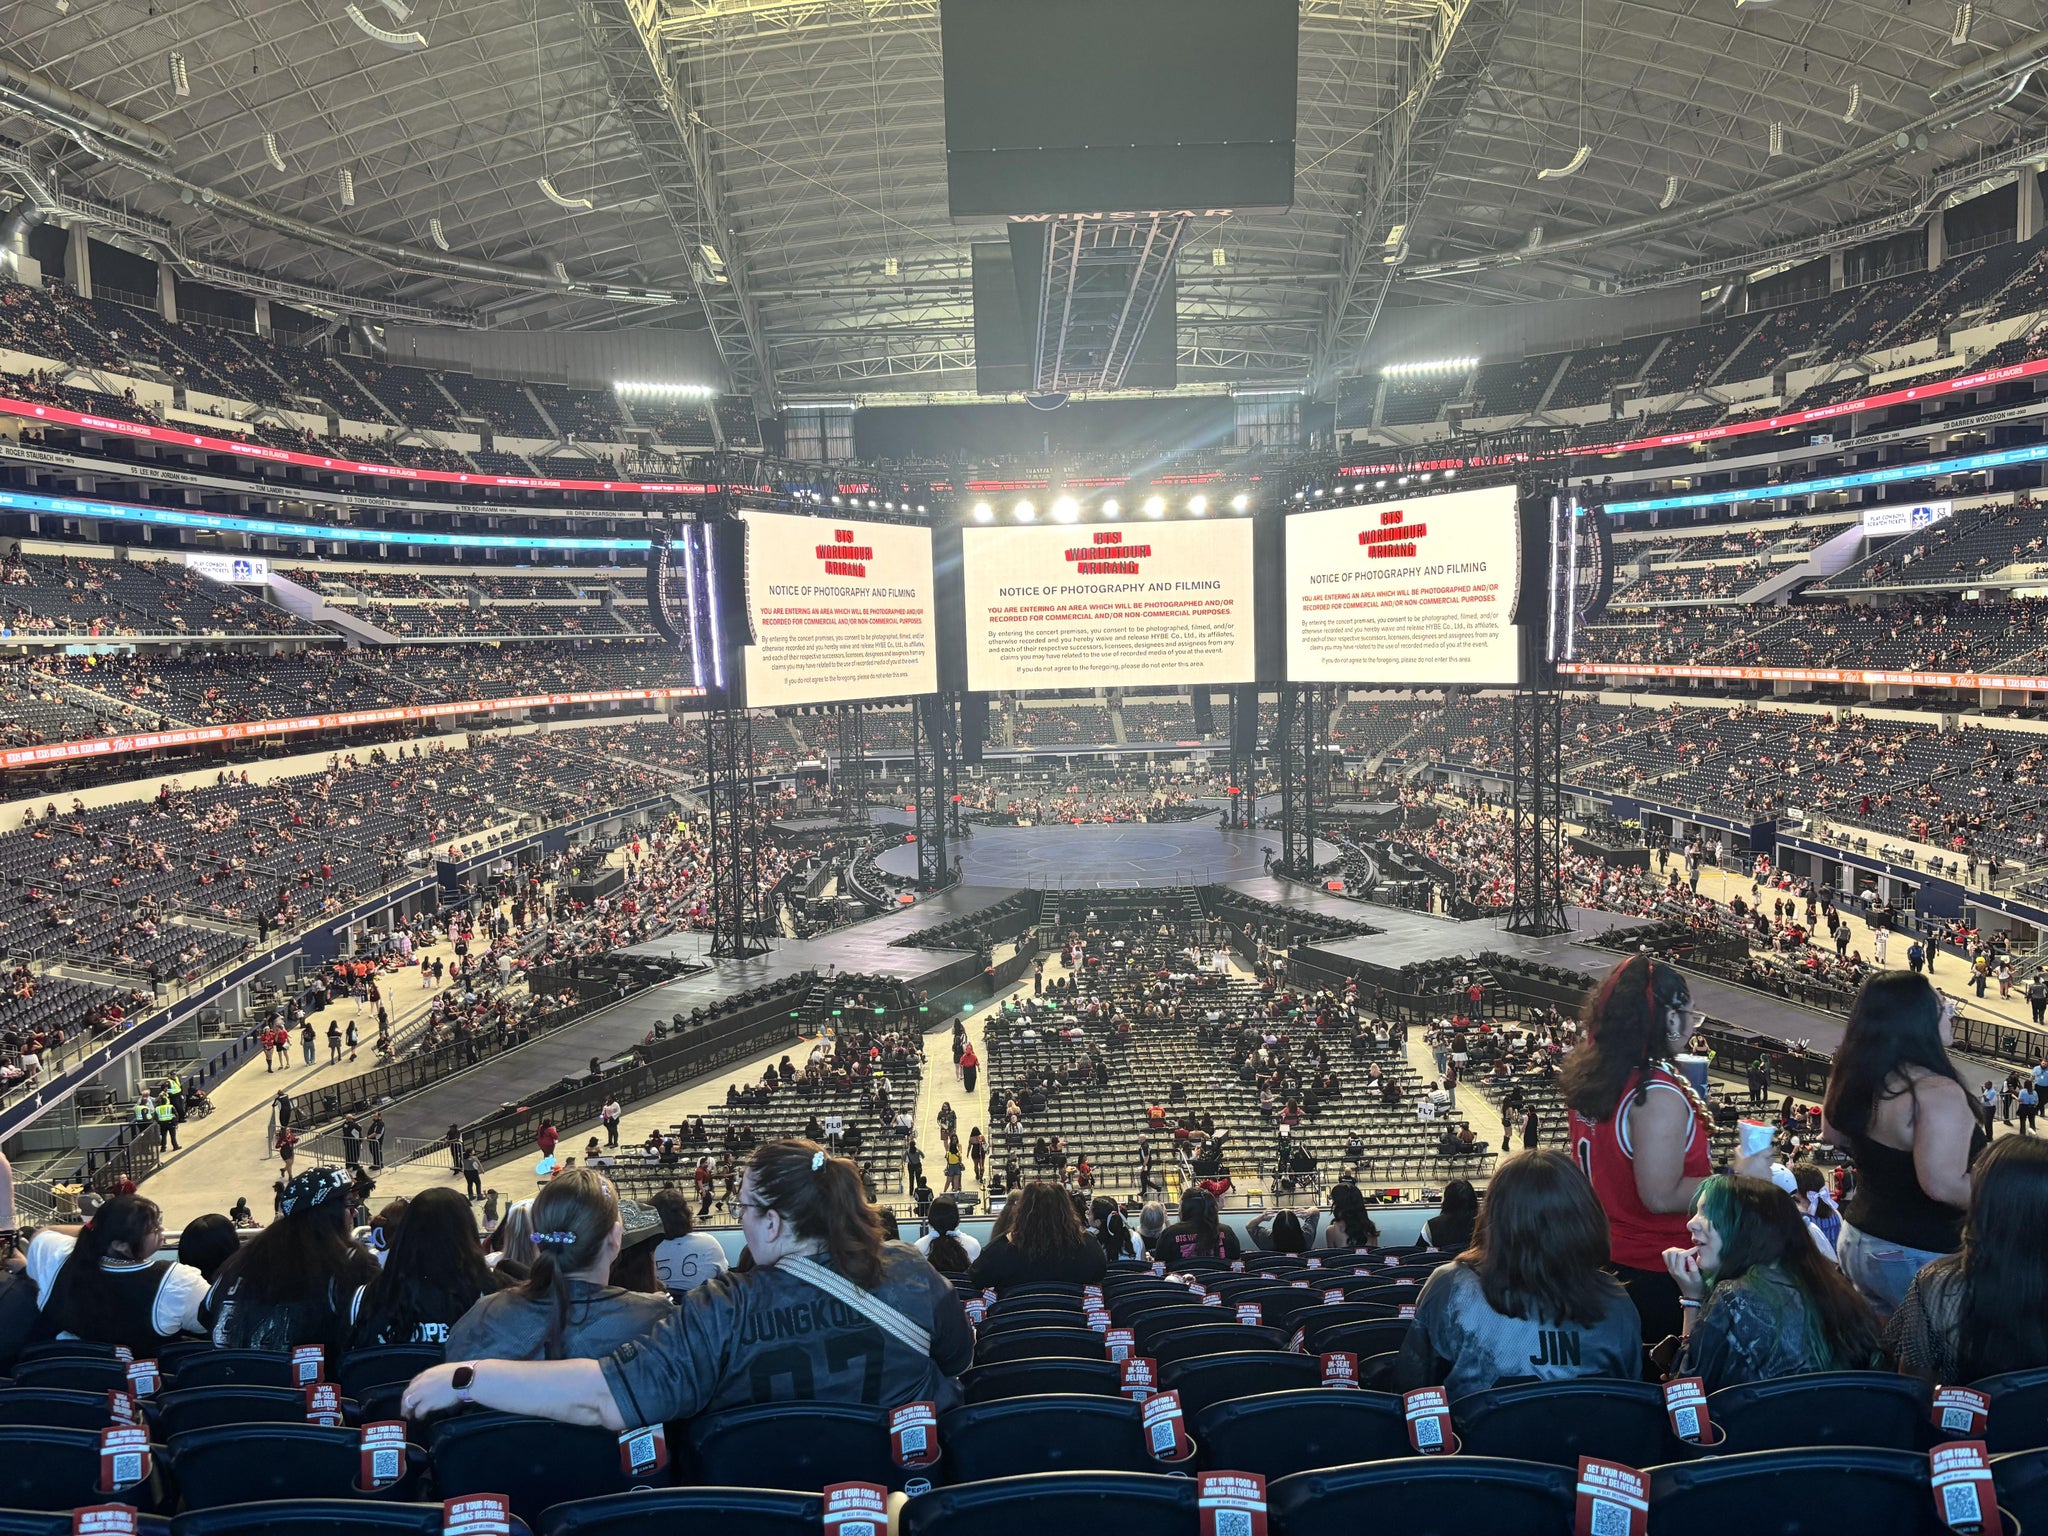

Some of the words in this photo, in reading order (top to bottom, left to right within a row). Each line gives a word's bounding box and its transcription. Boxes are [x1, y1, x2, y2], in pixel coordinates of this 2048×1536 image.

[1009, 209, 1232, 222] WINSTAR
[1996, 367, 2023, 378] FLAVORS
[1951, 419, 1974, 428] DARREN
[1976, 412, 2006, 423] WOODSON
[127, 425, 151, 435] FLAVORS
[1855, 436, 1879, 445] JOHNSON
[6, 448, 25, 457] ROGER
[26, 452, 54, 461] STAUBACH
[1383, 511, 1401, 525] BTS
[836, 530, 852, 543] BTS
[1096, 532, 1119, 544] BTS
[1362, 526, 1395, 544] WORLD
[1398, 524, 1423, 540] TOUR
[819, 544, 848, 559] WORLD
[850, 546, 870, 560] TOUR
[1070, 547, 1111, 561] WORLD
[1116, 545, 1147, 558] TOUR
[1372, 542, 1414, 559] ARIRANG
[828, 561, 863, 577] ARIRANG
[1082, 561, 1135, 575] ARIRANG
[1310, 573, 1340, 585] NOTICE
[1341, 572, 1353, 582] OF
[1354, 566, 1422, 581] PHOTOGRAPHY
[1424, 565, 1444, 576] AND
[1446, 561, 1487, 574] FILMING
[769, 585, 799, 596] NOTICE
[801, 586, 812, 596] OF
[814, 586, 870, 597] PHOTOGRAPHY
[872, 588, 887, 597] AND
[888, 588, 916, 598] FILMING
[1000, 586, 1040, 597] NOTICE
[1042, 586, 1058, 596] OF
[1060, 583, 1145, 595] PHOTOGRAPHY
[1148, 582, 1172, 592] AND
[1175, 580, 1221, 591] FILMING
[1324, 593, 1351, 601] ENTERING
[1420, 585, 1471, 595] PHOTOGRAPHED
[1472, 583, 1499, 593] AND/OR
[1144, 600, 1203, 609] PHOTOGRAPHED
[1204, 599, 1234, 607] AND/OR
[1343, 601, 1379, 609] COMMERCIAL
[1380, 599, 1404, 608] AND/OR
[1404, 596, 1460, 606] NON-COMMERCIAL
[1461, 594, 1496, 603] PURPOSES.
[1045, 613, 1093, 621] COMMERCIAL
[1094, 612, 1123, 620] AND/OR
[1124, 610, 1190, 618] NON-COMMERCIAL
[1956, 676, 1975, 688] Tito's
[114, 739, 133, 752] Tito's
[1530, 1331, 1581, 1366] JIN
[312, 1400, 338, 1409] DELIVERY
[1587, 1464, 1599, 1474] GET
[1600, 1467, 1617, 1478] YOUR
[1619, 1471, 1634, 1483] FOOD
[1206, 1478, 1217, 1487] GET
[1218, 1477, 1235, 1486] YOUR
[1236, 1478, 1251, 1488] FOOD
[1584, 1473, 1607, 1485] DRINKS
[1608, 1478, 1644, 1497] DELIVERED!
[832, 1490, 843, 1500] GET
[844, 1488, 859, 1498] YOUR
[861, 1489, 875, 1499] FOOD
[1204, 1487, 1226, 1496] DRINKS
[1227, 1487, 1260, 1499] DELIVERED!
[829, 1500, 850, 1510] DRINKS
[852, 1499, 883, 1510] DELIVERED!
